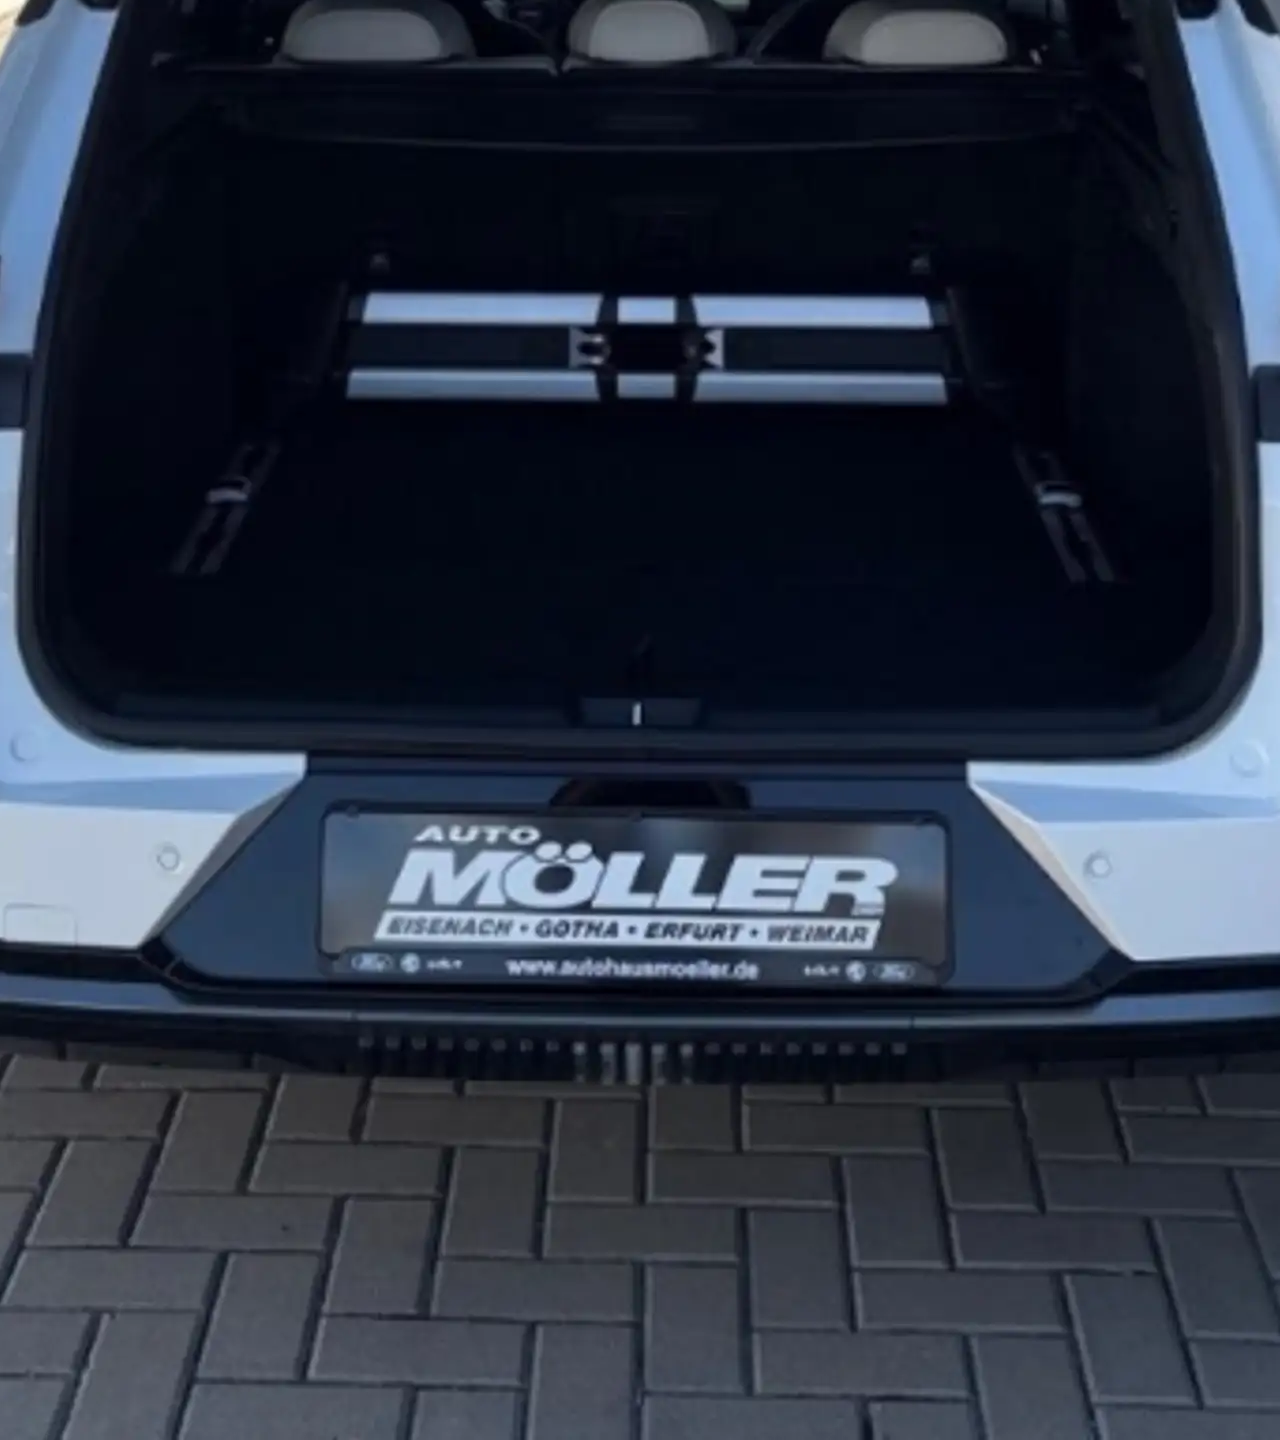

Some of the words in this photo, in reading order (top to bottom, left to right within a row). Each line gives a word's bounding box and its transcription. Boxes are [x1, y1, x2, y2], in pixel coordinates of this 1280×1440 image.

[414, 824, 541, 845] AUTO
[387, 841, 898, 914] MÖLLER
[385, 915, 513, 936] EISENACH
[534, 918, 619, 939] GOTHA
[644, 921, 743, 941] ERFURT
[767, 924, 870, 945] WEIMAR
[505, 956, 760, 981] www.autohausmoeller.de
